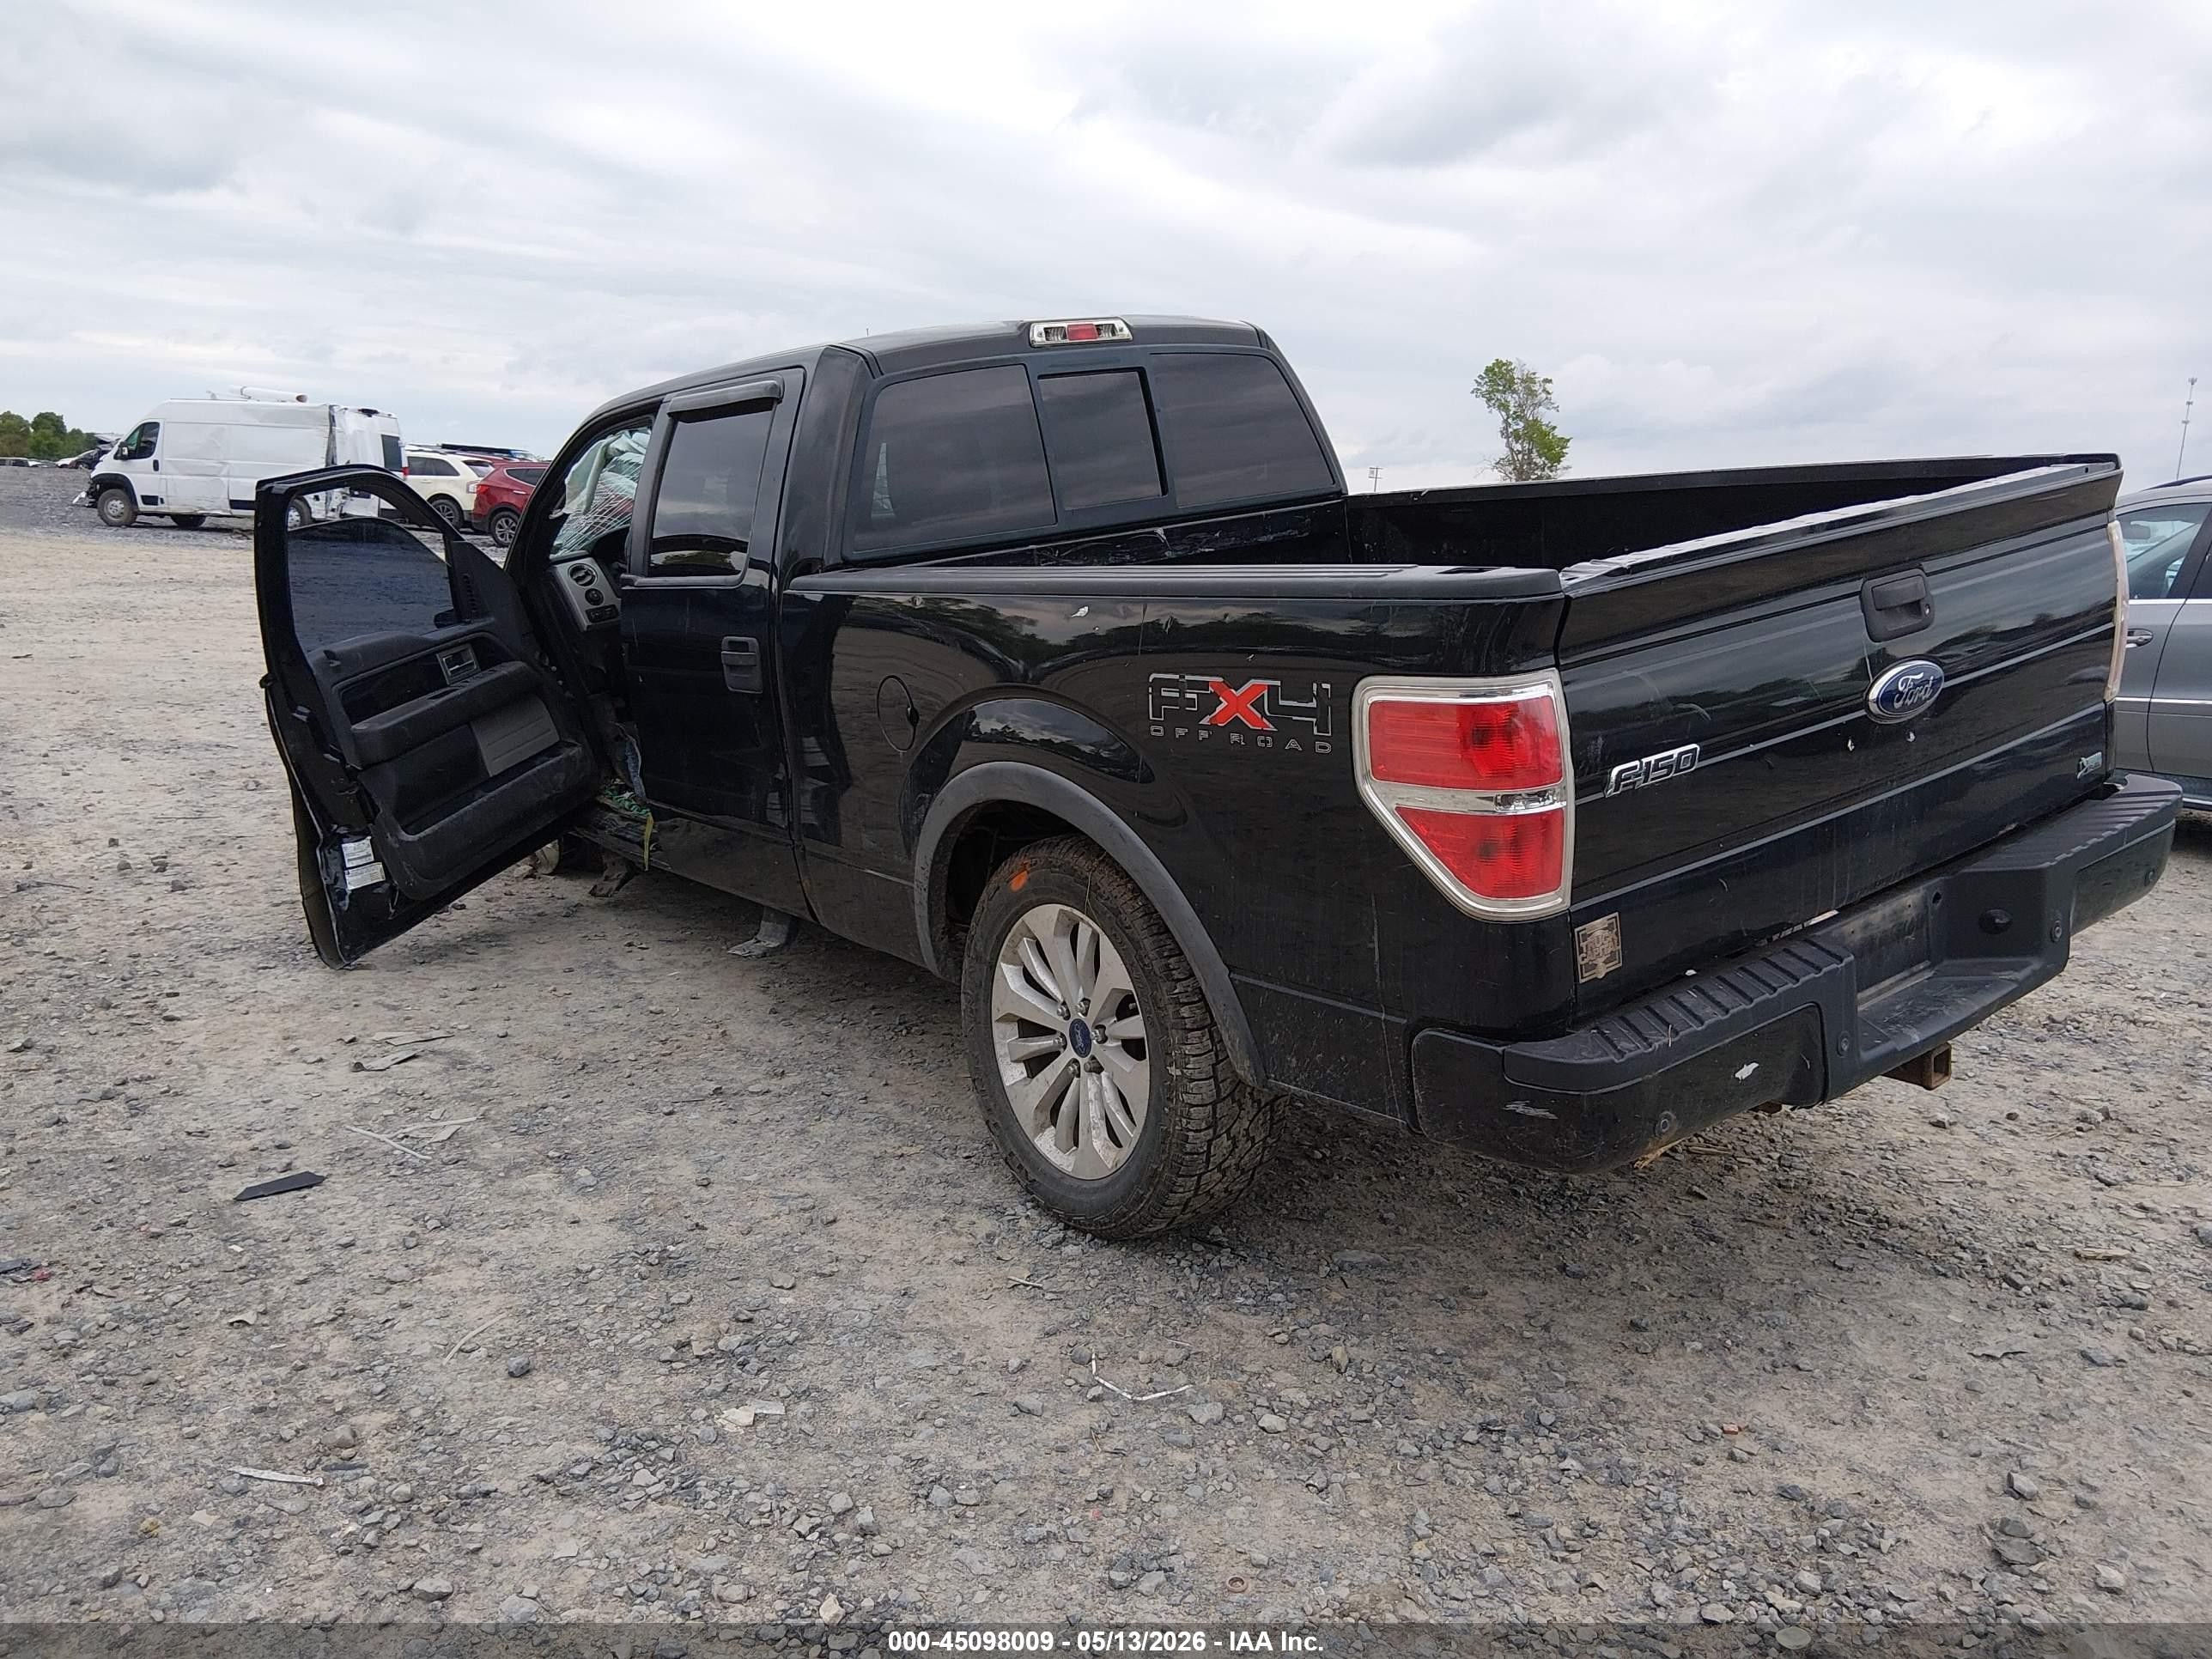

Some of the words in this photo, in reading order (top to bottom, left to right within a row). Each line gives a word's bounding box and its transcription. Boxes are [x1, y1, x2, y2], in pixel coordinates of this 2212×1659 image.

[1149, 673, 1331, 736] FX4
[1893, 672, 1934, 709] Ford
[1150, 725, 1212, 741] OFF
[1230, 732, 1332, 754] ROAD
[1606, 743, 1700, 798] F-150
